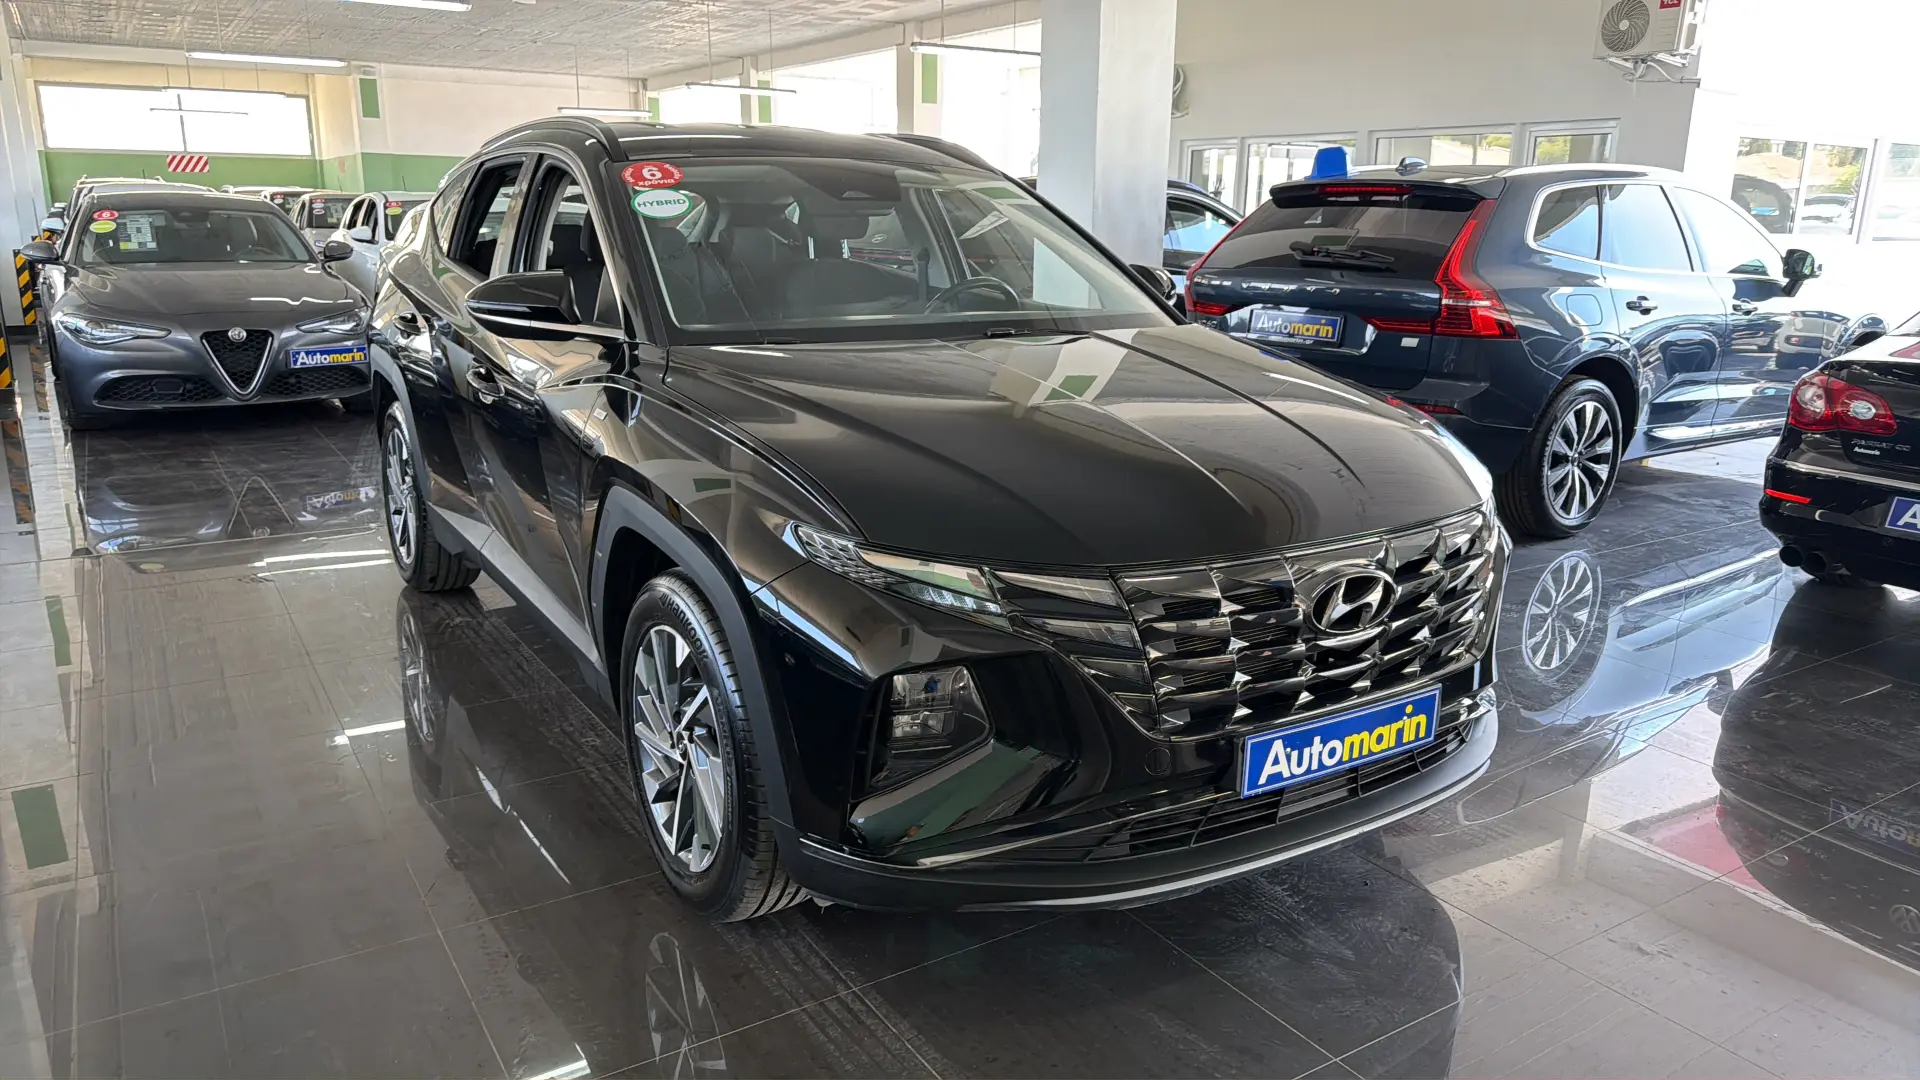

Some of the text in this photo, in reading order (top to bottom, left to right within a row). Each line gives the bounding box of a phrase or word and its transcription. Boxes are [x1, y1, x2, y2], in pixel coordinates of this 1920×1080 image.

[641, 167, 663, 180] 6
[637, 199, 687, 208] HYBRID
[1256, 313, 1333, 338] Automarin
[296, 348, 365, 366] Automarin
[1257, 704, 1427, 786] Automarin
